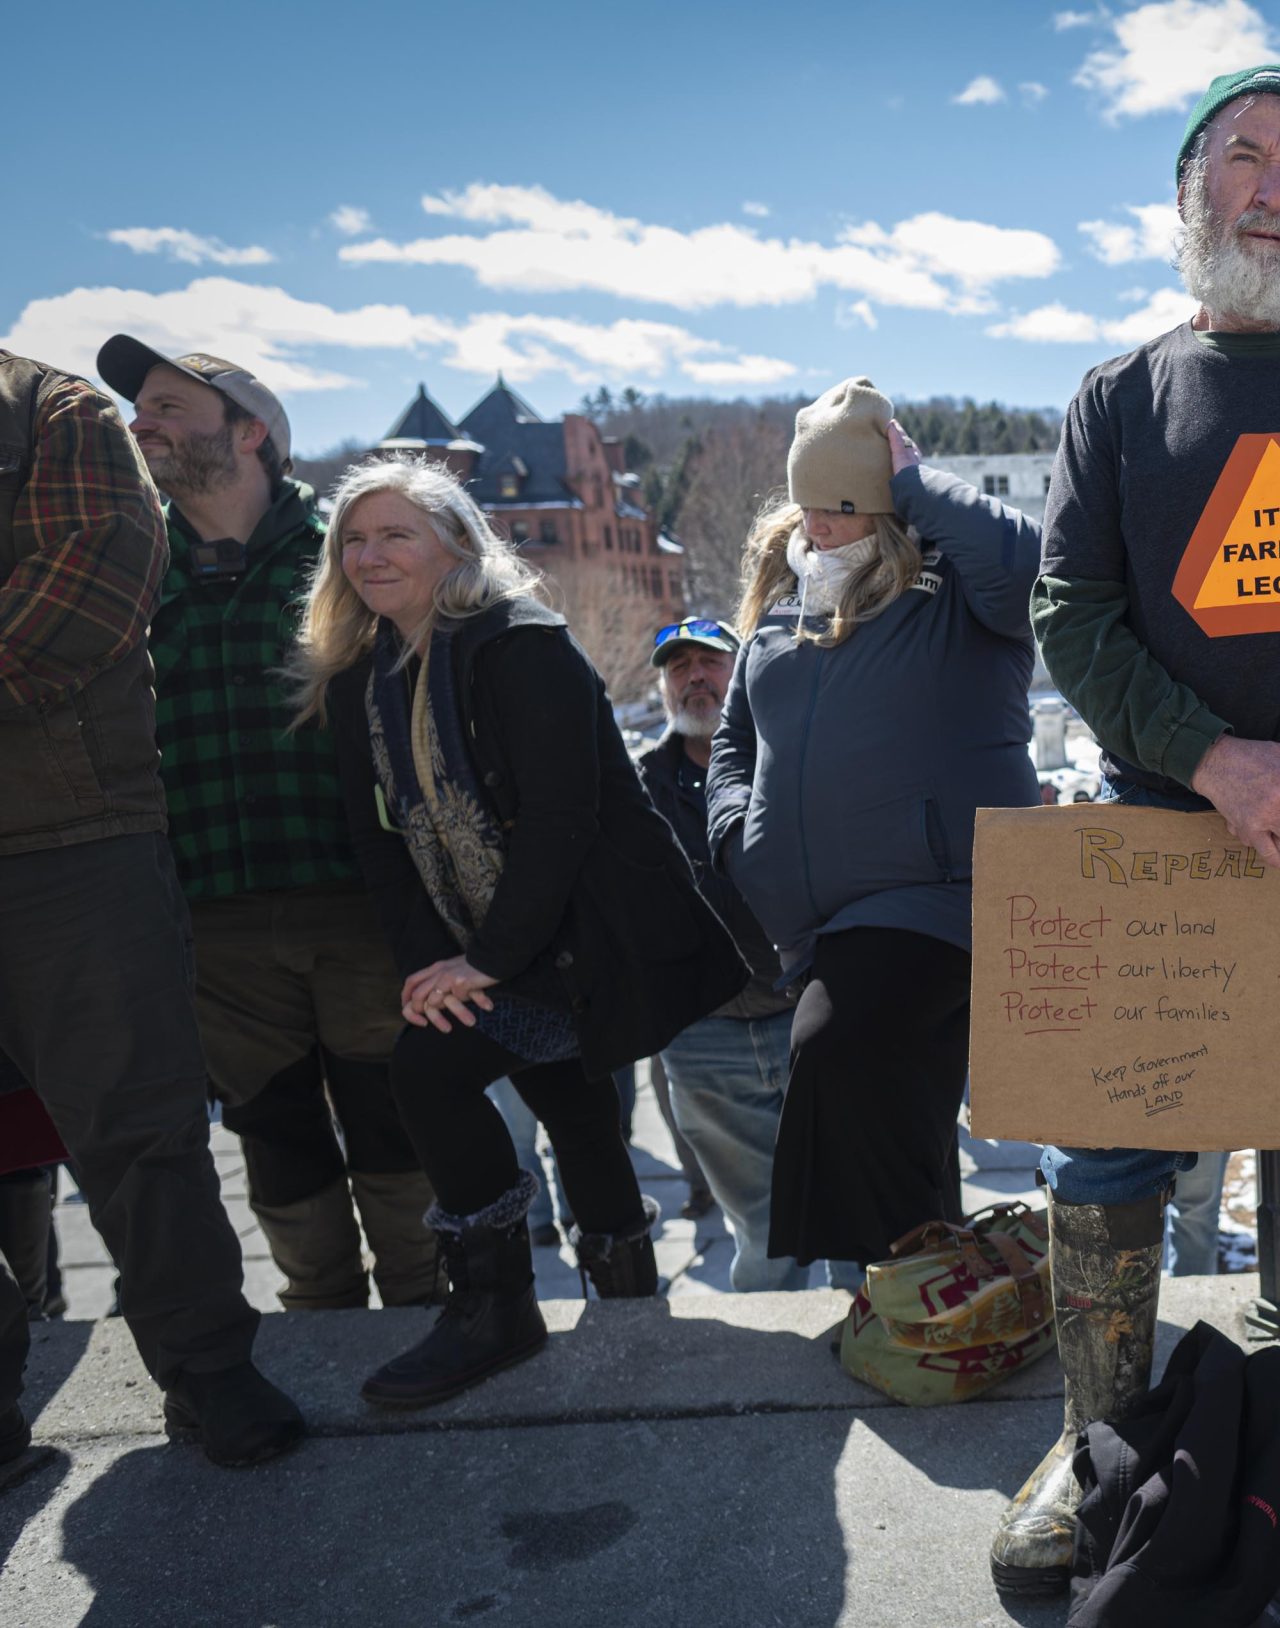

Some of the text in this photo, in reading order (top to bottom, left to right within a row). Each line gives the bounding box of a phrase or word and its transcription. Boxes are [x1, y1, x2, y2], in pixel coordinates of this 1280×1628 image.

[1074, 828, 1265, 888] REPEAL
[1006, 895, 1216, 940] Protect our land
[1003, 949, 1237, 993] Protect our liberty
[1000, 991, 1231, 1022] Protect our families
[1091, 1044, 1209, 1087] Keep Government
[1107, 1069, 1196, 1103] Hands off our
[1144, 1090, 1183, 1109] LAND
